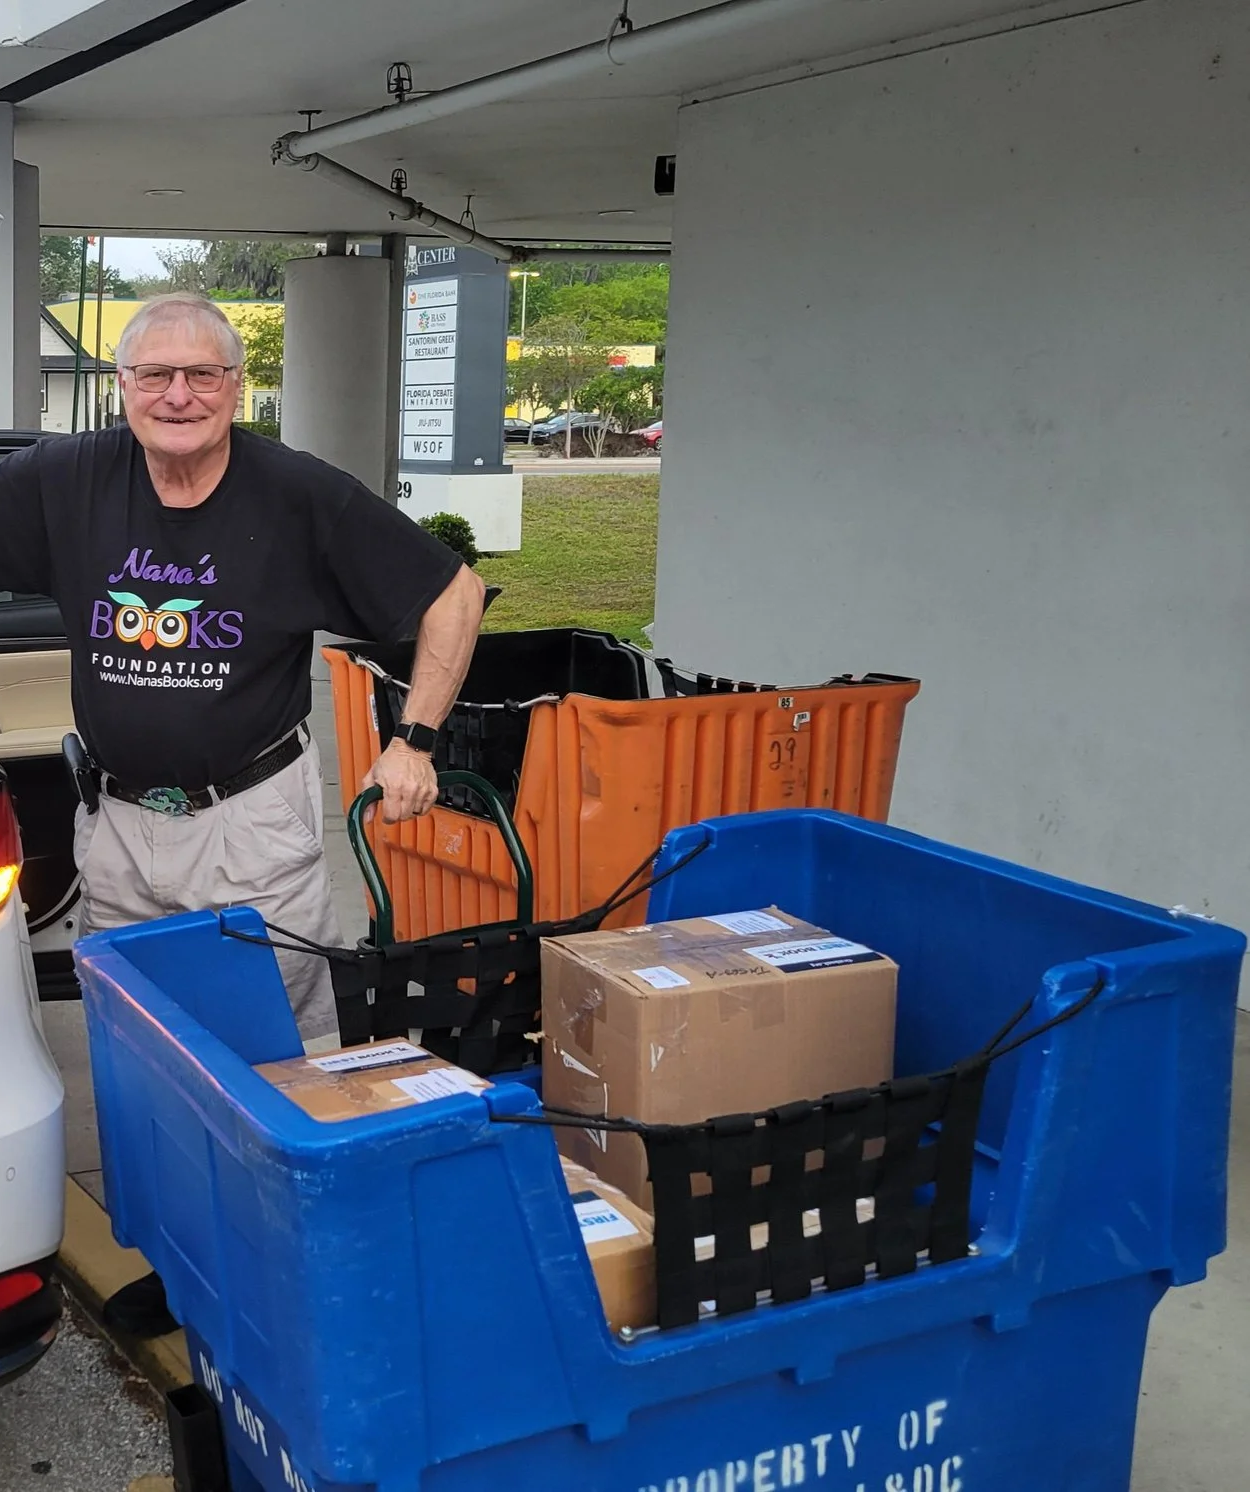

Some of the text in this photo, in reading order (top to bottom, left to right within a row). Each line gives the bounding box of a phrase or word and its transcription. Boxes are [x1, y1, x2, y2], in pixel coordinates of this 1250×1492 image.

[417, 246, 456, 265] CENTER
[427, 291, 445, 299] FLORIDA
[430, 313, 447, 322] BASS
[408, 335, 455, 346] SANTORINI GREEK
[414, 346, 449, 356] RESTAURANT
[406, 389, 453, 398] FLORIDA DEBATE
[406, 398, 453, 406] INITIATIVE
[417, 418, 442, 427] JIU-JITSU
[413, 441, 443, 454] WSOF
[108, 547, 218, 585] Nana's
[90, 599, 244, 649] BOOKS
[91, 652, 231, 675] FOUNDATION
[100, 671, 224, 691] www.NanasBooks.org
[781, 697, 791, 709] 85
[199, 1351, 224, 1404] DO
[232, 1388, 269, 1457] NOT
[899, 1399, 948, 1450] OF
